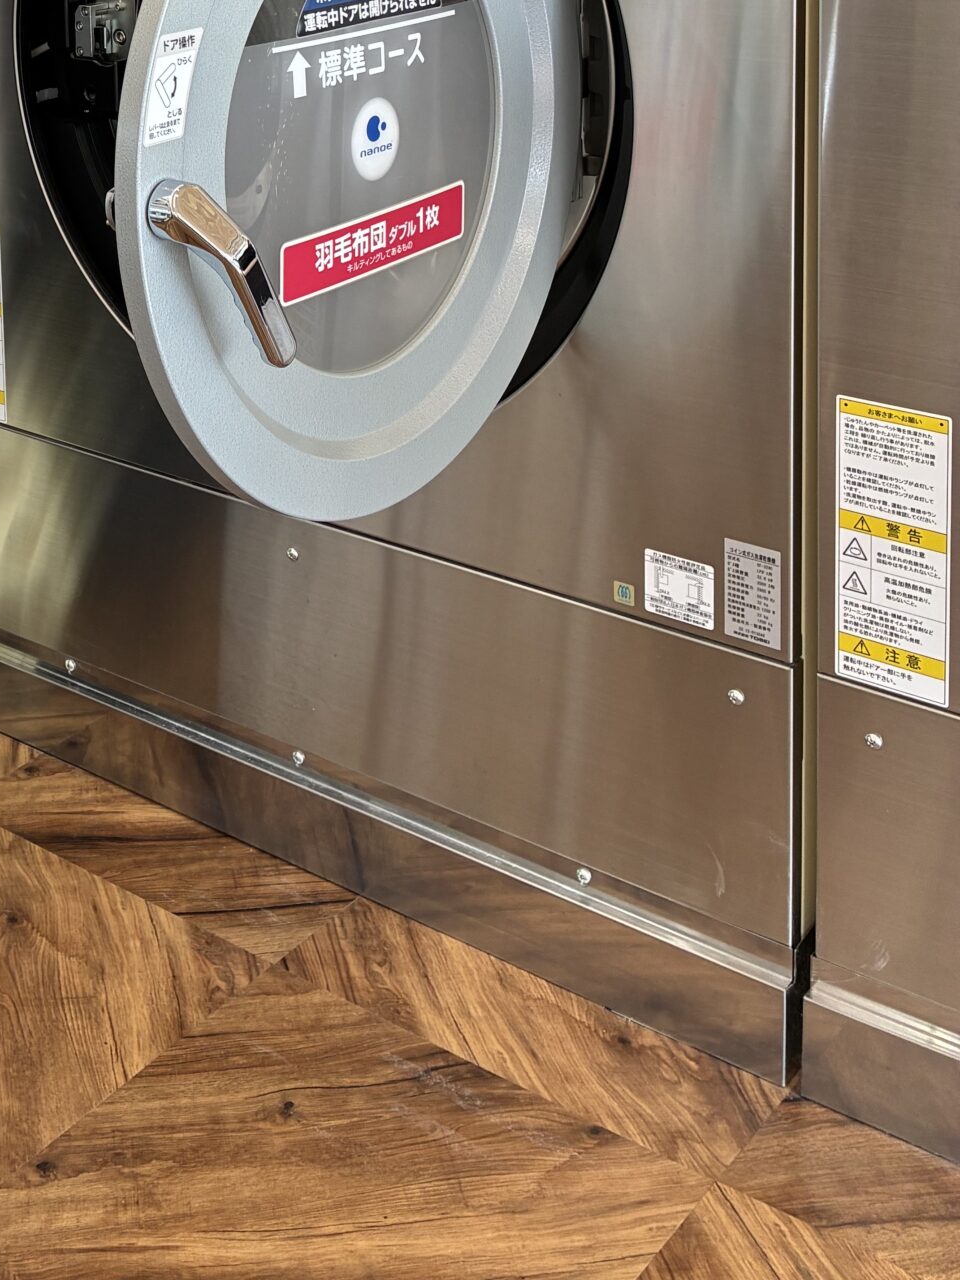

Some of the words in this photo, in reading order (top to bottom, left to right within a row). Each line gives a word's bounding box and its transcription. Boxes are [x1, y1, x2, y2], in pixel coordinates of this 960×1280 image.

[163, 35, 195, 52] ドア操作
[177, 56, 192, 66] ひらく
[318, 33, 425, 88] 標準コース
[360, 142, 393, 159] nanoe
[315, 221, 386, 271] 羽毛布団
[346, 240, 414, 273] キルティングしてあるもの
[886, 522, 922, 544] 警告
[886, 648, 921, 670] 注意
